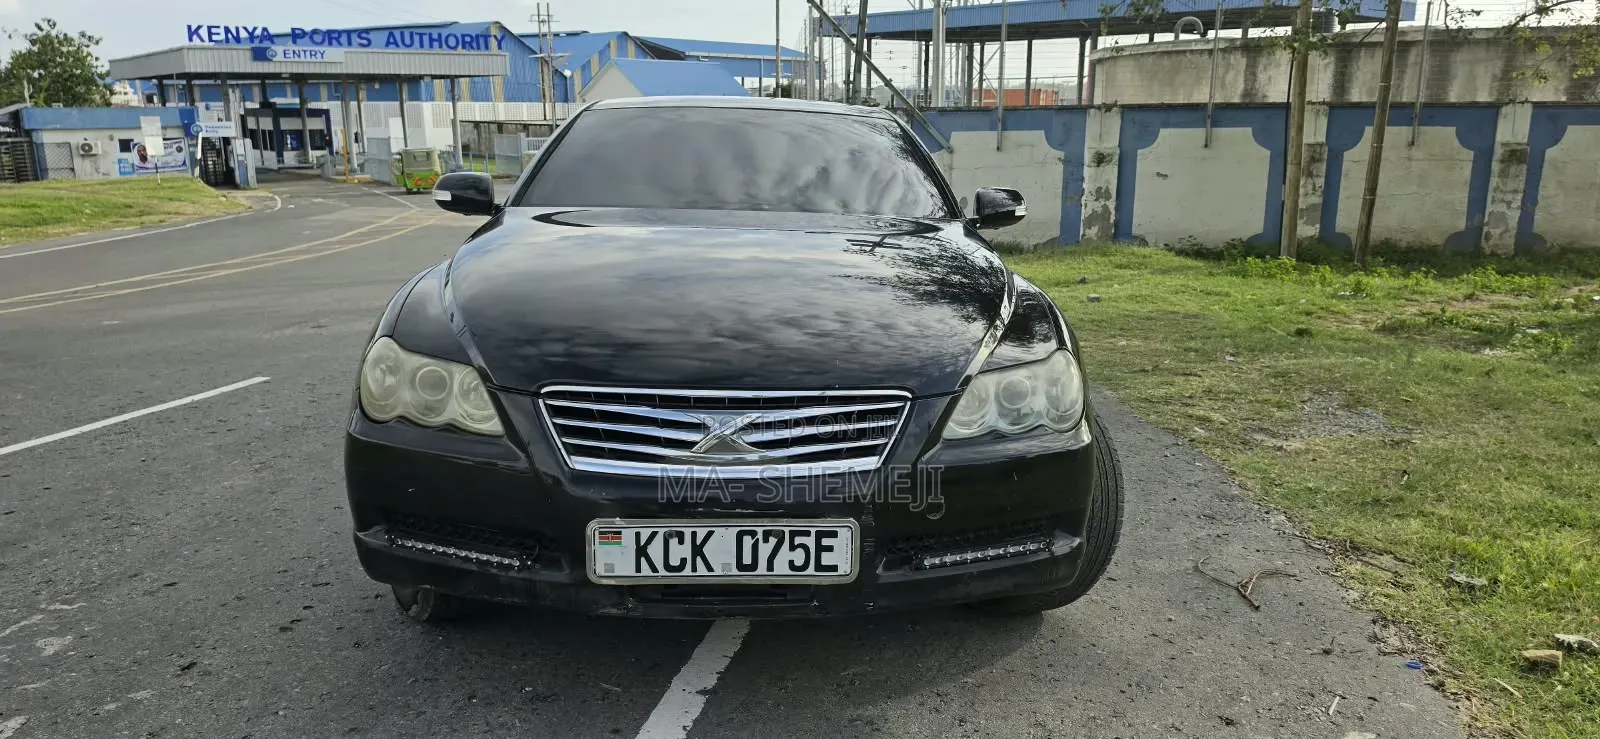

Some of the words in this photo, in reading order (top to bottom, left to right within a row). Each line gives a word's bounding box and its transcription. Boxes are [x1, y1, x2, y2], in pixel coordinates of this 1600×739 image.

[186, 24, 275, 45] KENYA
[290, 27, 372, 48] PORTS
[385, 31, 506, 51] AUTHORITY
[283, 49, 326, 60] ENTRY
[634, 530, 716, 574] KCK
[735, 529, 839, 573] 075E
